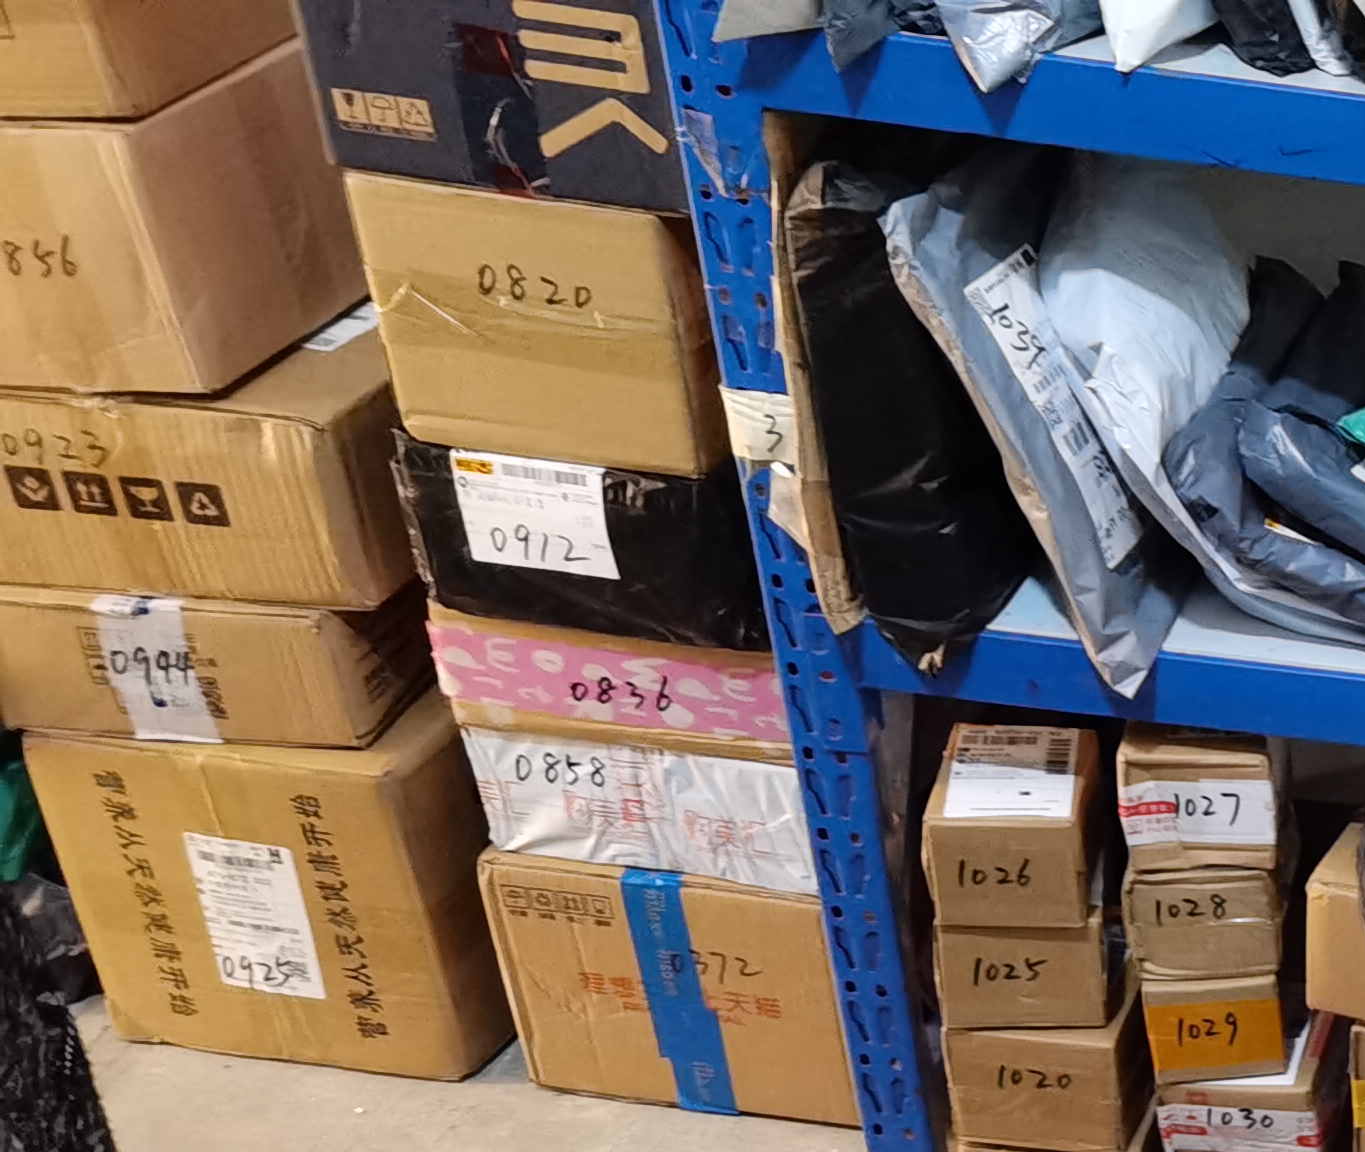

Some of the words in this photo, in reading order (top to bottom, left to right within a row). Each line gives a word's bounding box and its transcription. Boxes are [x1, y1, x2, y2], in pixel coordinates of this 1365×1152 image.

[477, 263, 593, 309] 0820
[2, 428, 111, 468] 0923
[763, 413, 784, 453] 3
[490, 523, 592, 562] 0912
[570, 675, 674, 712] 0836
[514, 752, 606, 787] 0858
[1173, 792, 1241, 827] 1027
[958, 857, 1032, 889] 1026
[1155, 893, 1228, 927] 1028
[221, 955, 292, 989] 0925
[973, 956, 1051, 987] 1025
[1177, 1011, 1239, 1047] 1029
[998, 1064, 1073, 1090] 1020
[1206, 1107, 1275, 1130] 1030
